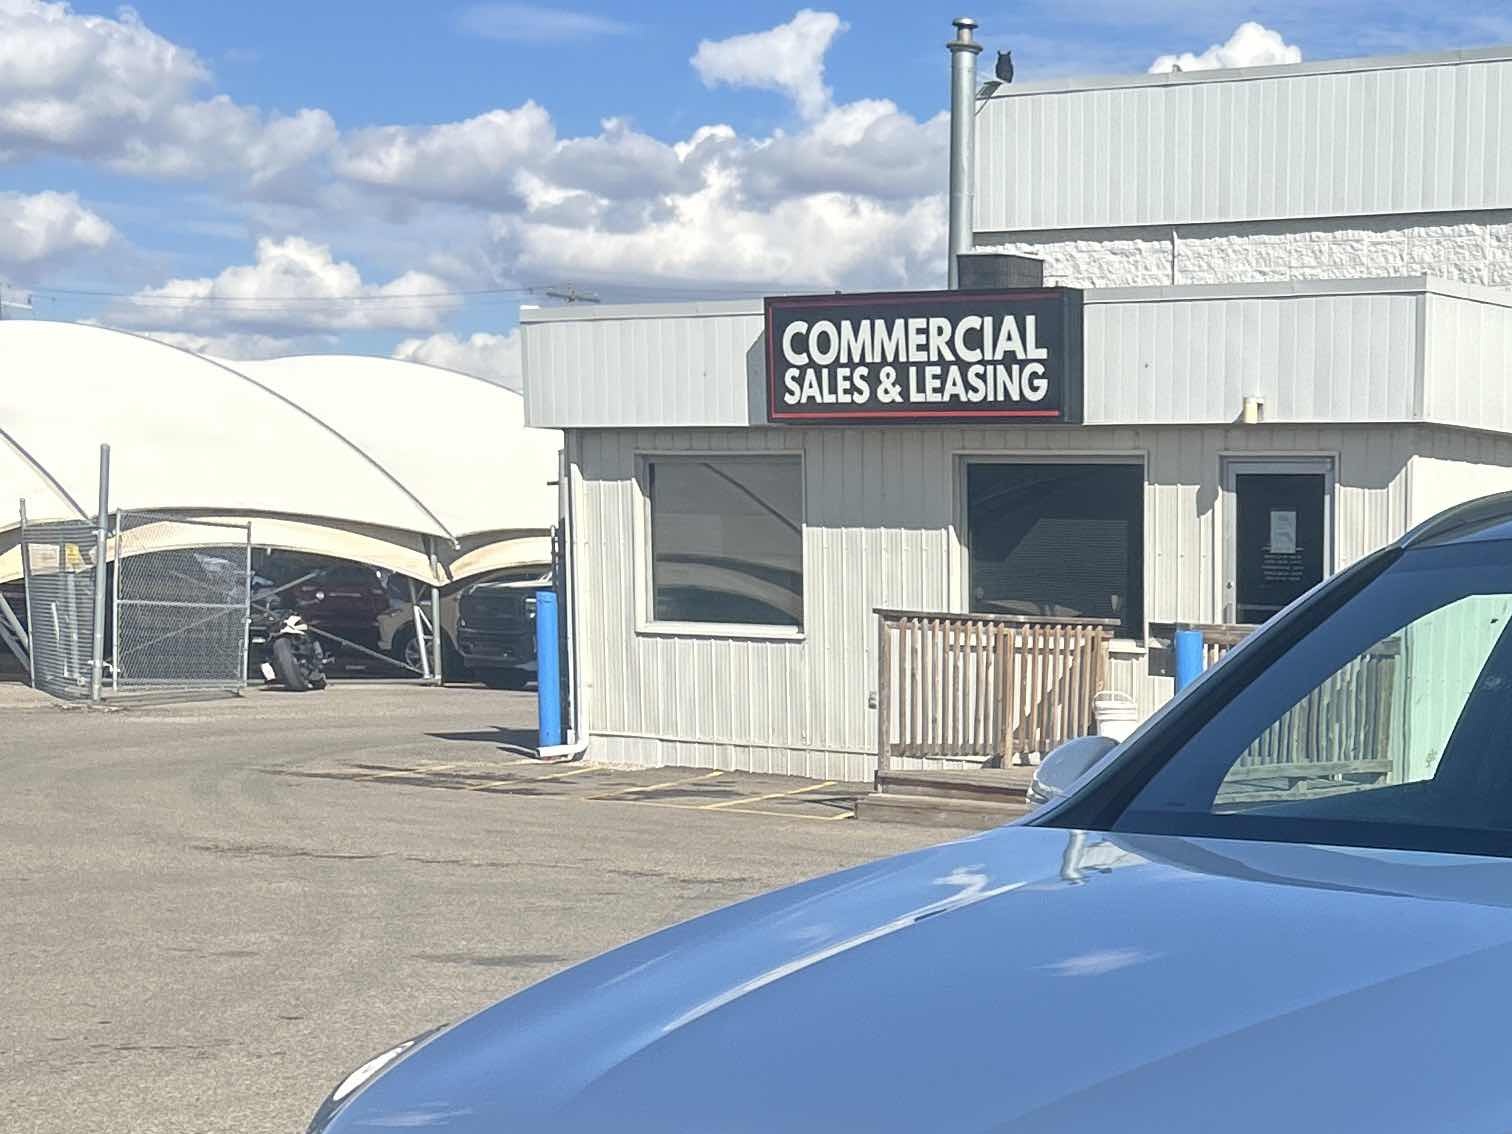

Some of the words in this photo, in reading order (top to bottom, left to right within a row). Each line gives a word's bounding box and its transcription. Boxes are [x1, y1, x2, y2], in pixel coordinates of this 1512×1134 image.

[782, 314, 1048, 366] COMMERCIAL
[783, 365, 871, 405] SALES
[876, 364, 904, 404] &
[907, 362, 1050, 404] LEASING
